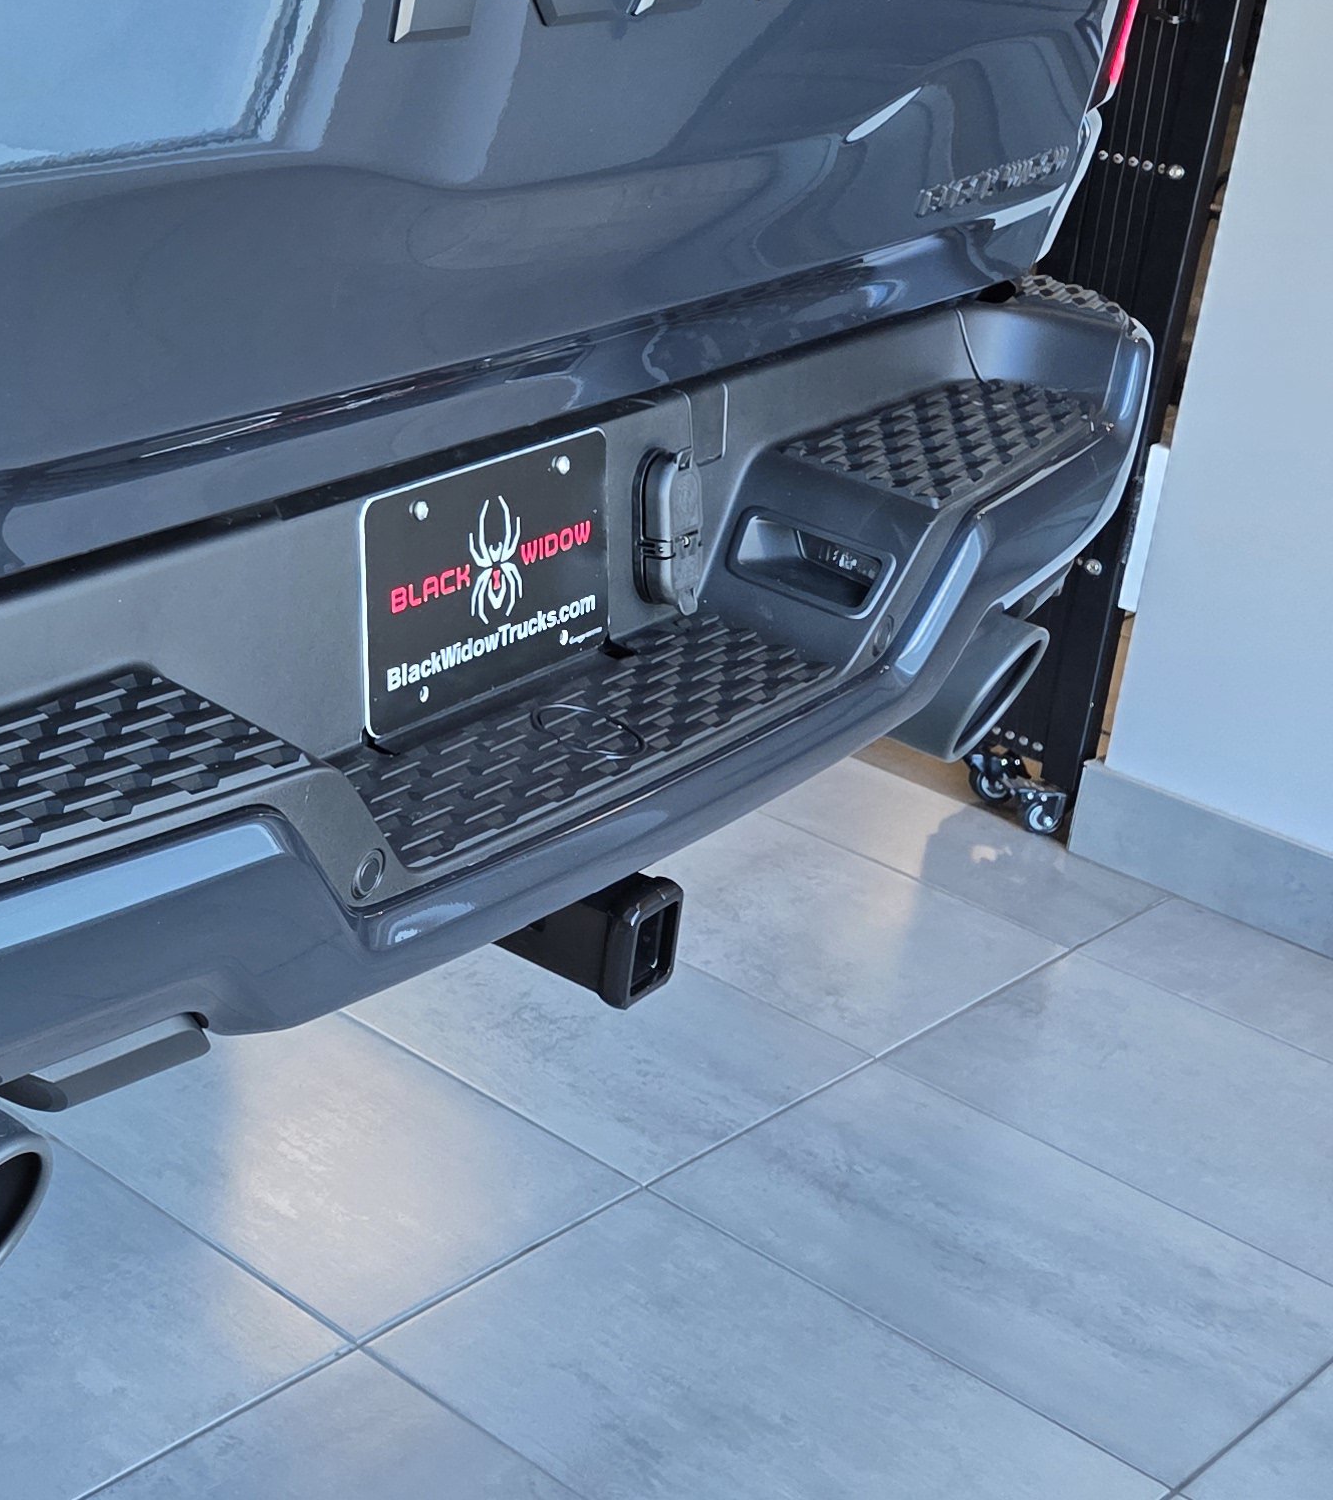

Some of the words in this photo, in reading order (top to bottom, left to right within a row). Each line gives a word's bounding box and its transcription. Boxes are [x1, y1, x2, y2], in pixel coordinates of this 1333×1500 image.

[390, 563, 471, 614] BLACK
[520, 520, 592, 566] WIDOW
[386, 593, 597, 693] BlackWidowTrucks.com
